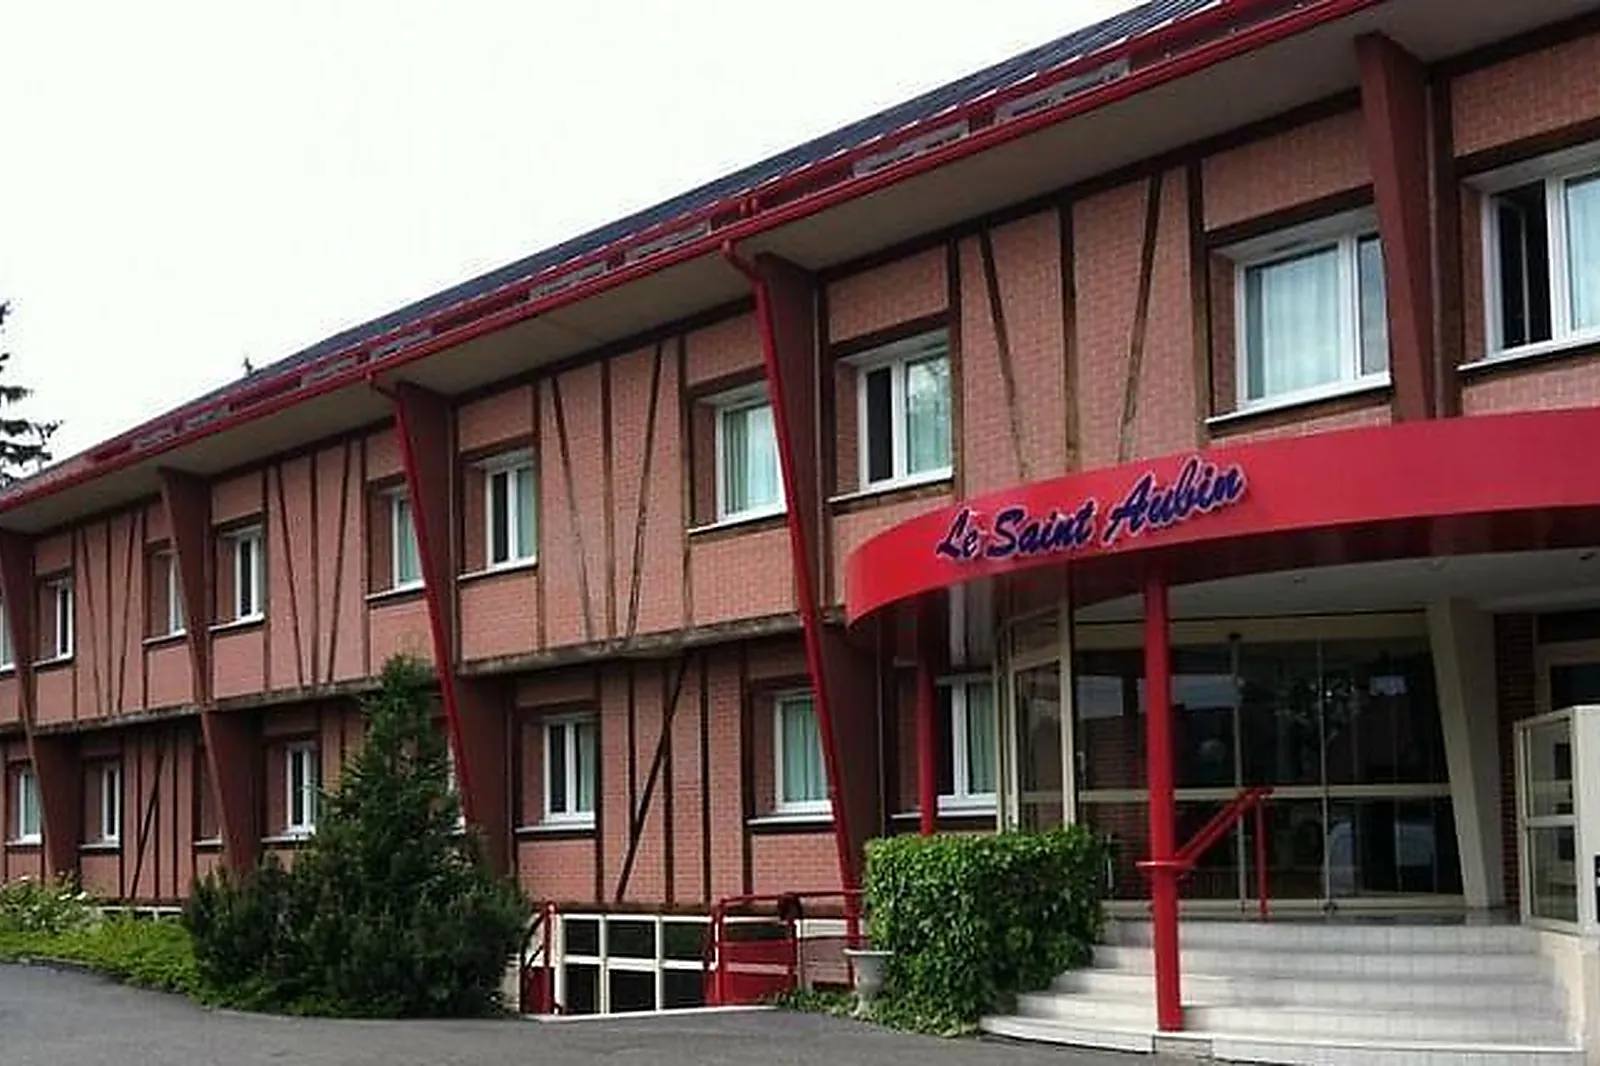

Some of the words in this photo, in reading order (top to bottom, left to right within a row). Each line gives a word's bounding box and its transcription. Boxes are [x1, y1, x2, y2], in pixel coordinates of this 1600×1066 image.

[936, 508, 980, 558] Le
[986, 499, 1096, 557] Saint
[1102, 456, 1245, 543] Aubin
